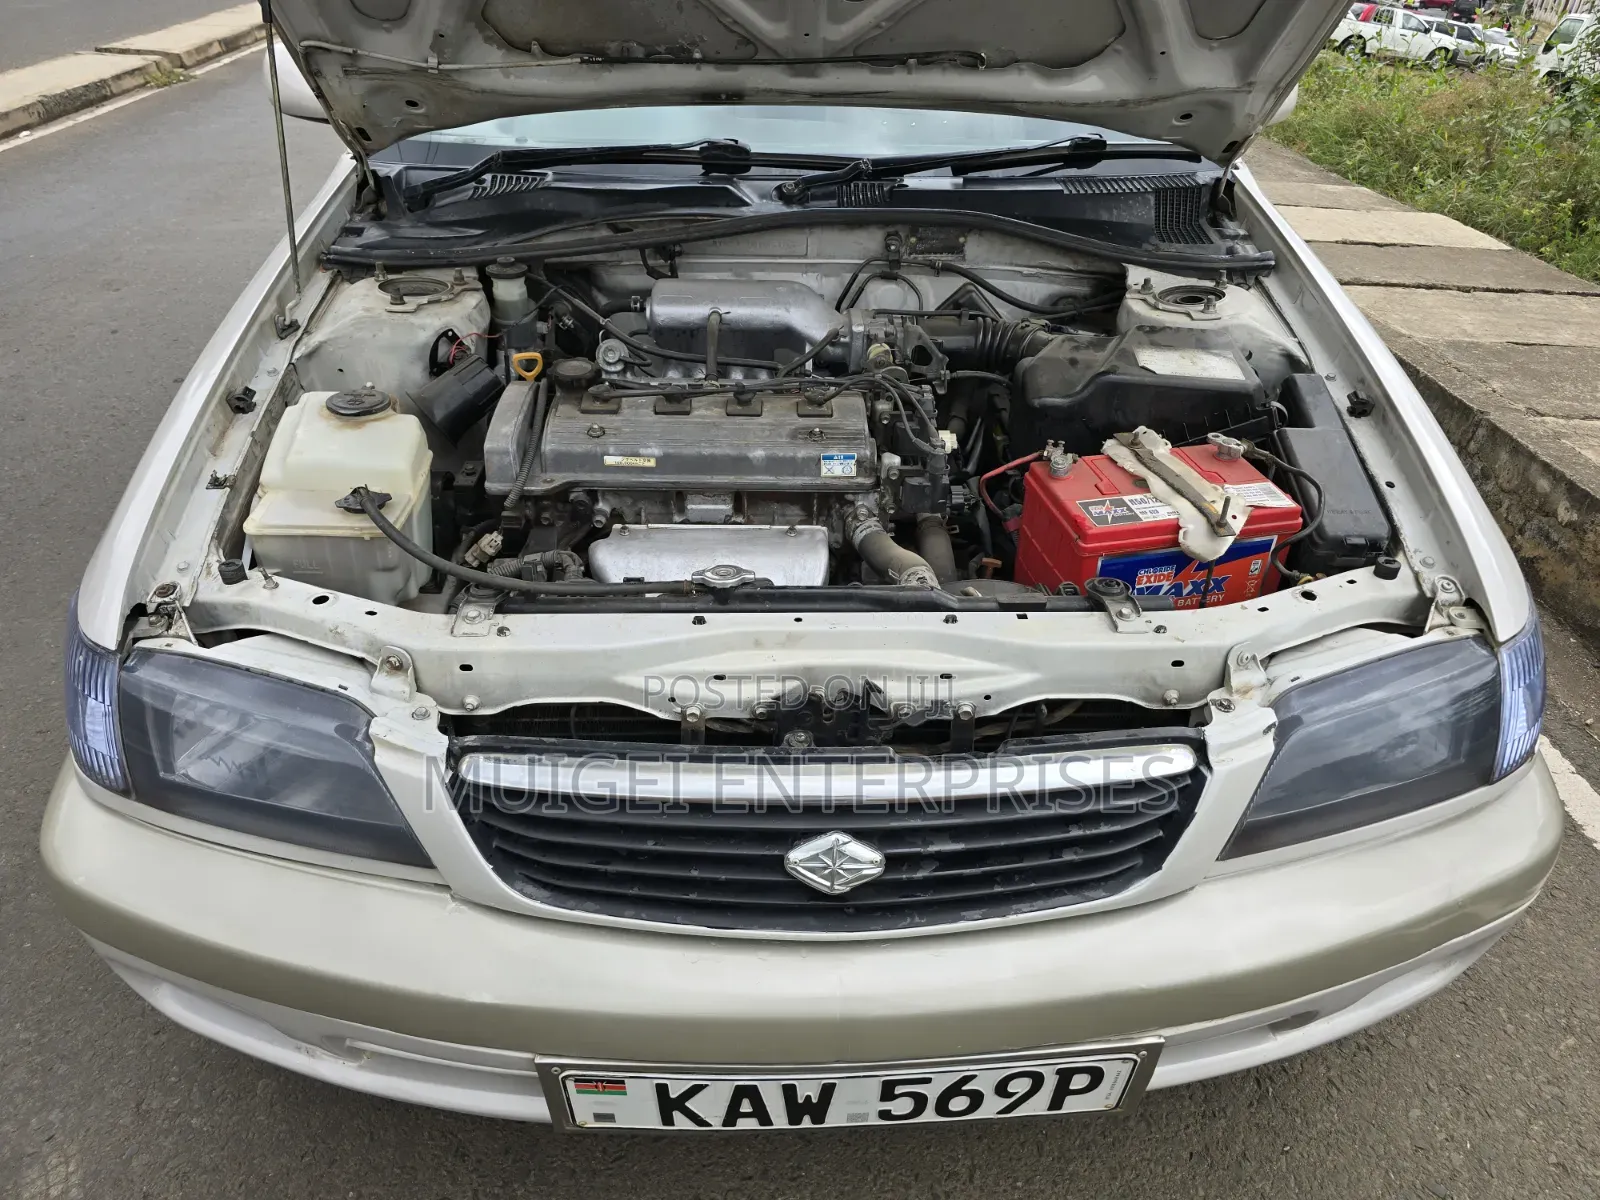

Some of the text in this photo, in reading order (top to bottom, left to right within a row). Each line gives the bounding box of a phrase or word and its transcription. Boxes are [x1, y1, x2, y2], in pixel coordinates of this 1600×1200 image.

[1138, 564, 1176, 576] CHLORIDE
[1136, 571, 1174, 586] EXIDE
[1131, 574, 1232, 599] MAXX
[1177, 594, 1225, 607] BATERY
[655, 1082, 838, 1128] KAW
[877, 1065, 1105, 1122] 569P
